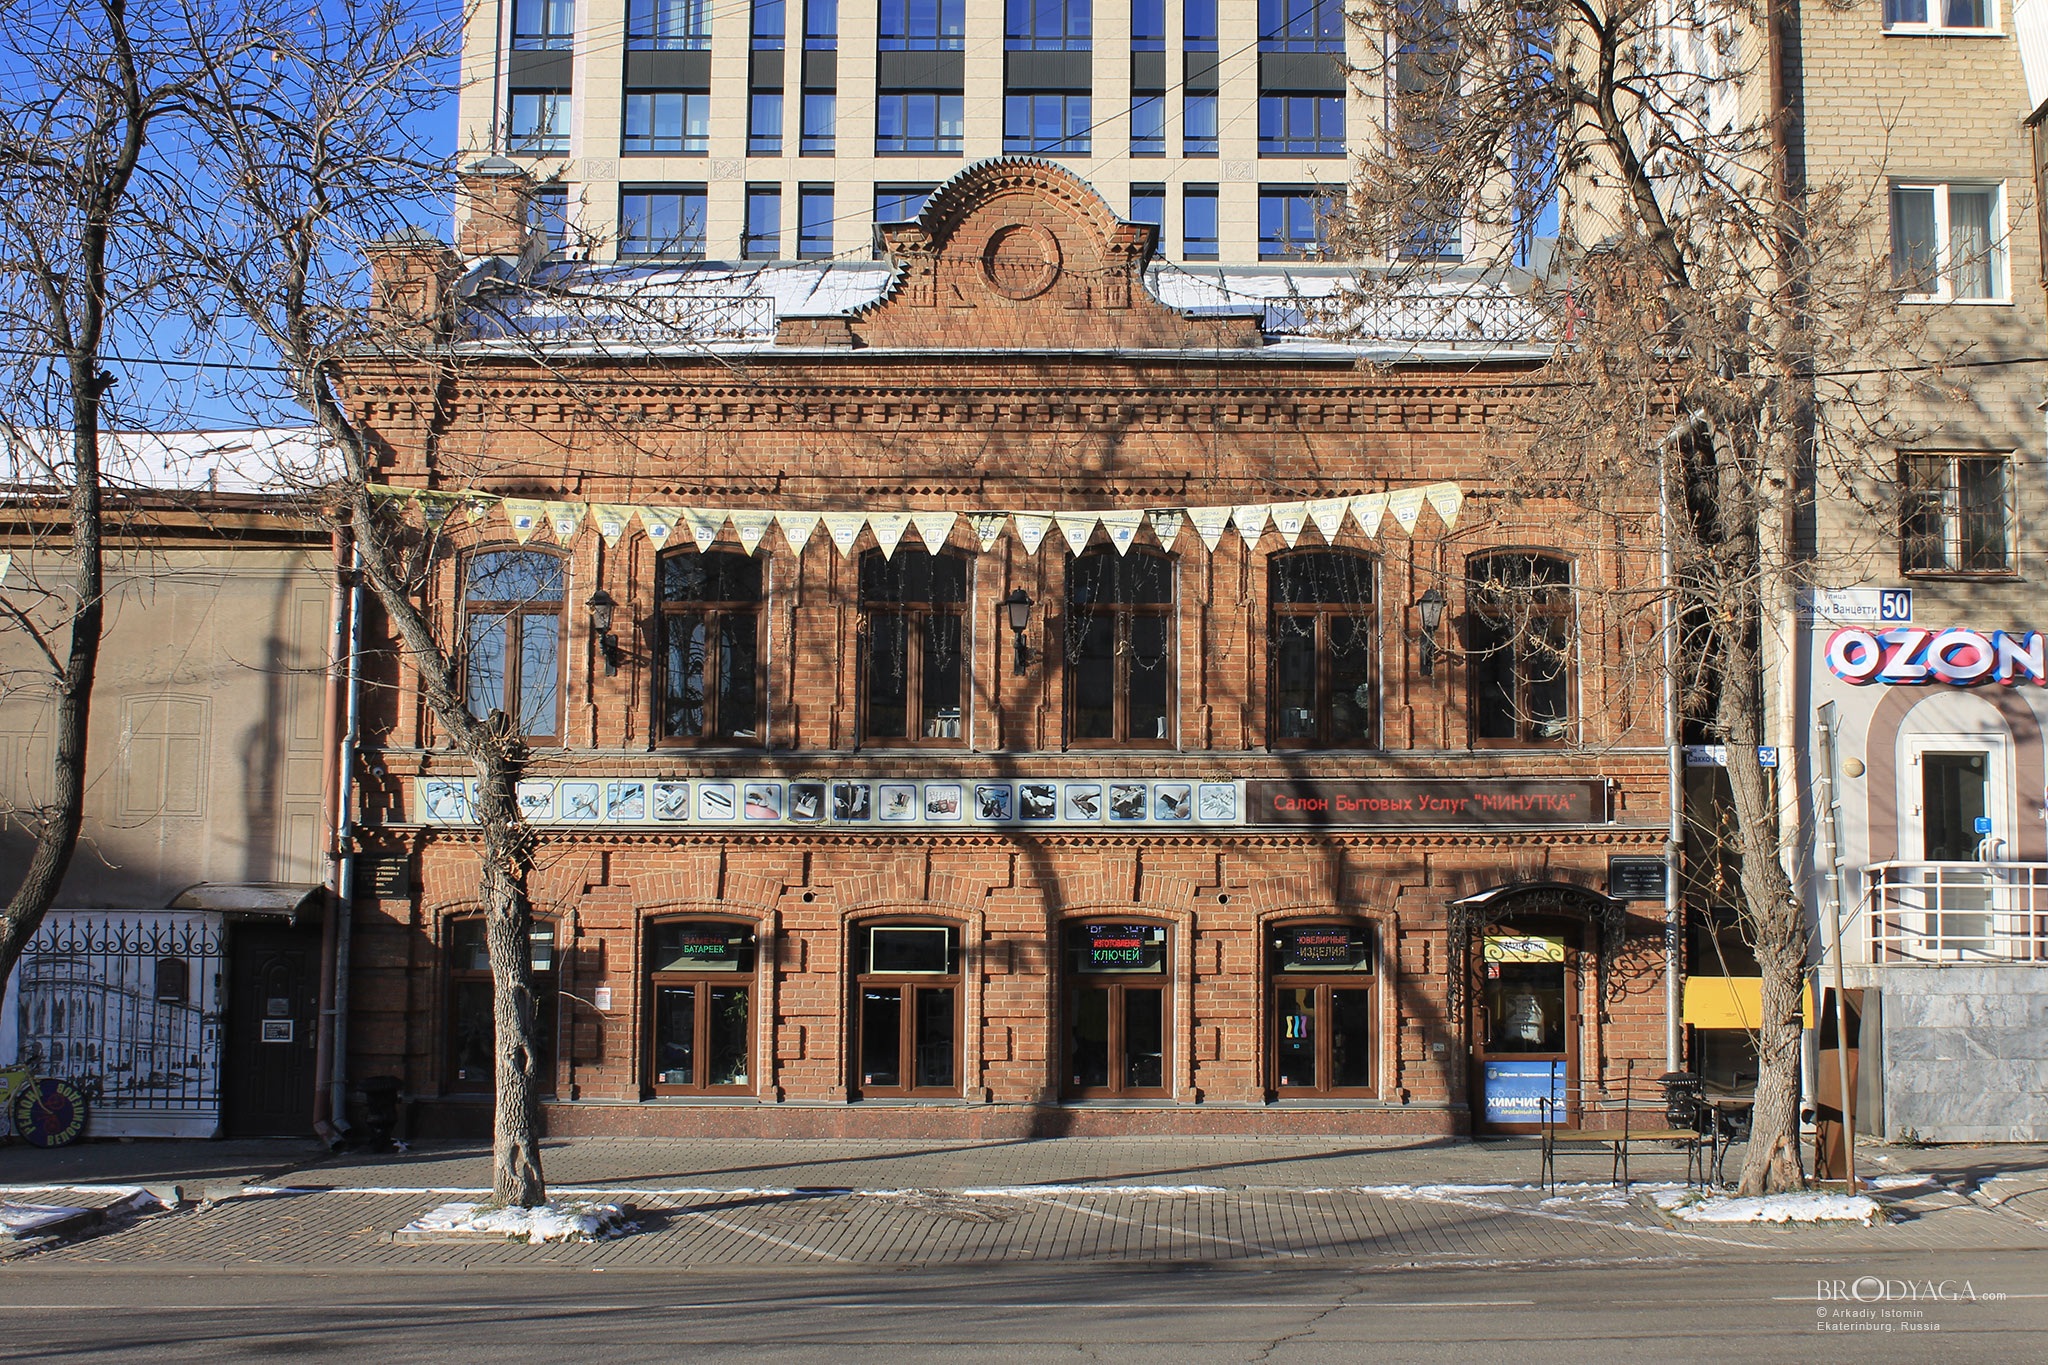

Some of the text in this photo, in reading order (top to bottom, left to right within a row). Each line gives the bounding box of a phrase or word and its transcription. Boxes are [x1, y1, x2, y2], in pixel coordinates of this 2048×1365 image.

[1833, 603, 1877, 614] Ванцетти
[1882, 592, 1909, 618] 50
[1827, 628, 2046, 683] OZON
[1758, 750, 1775, 763] 52
[1274, 793, 1576, 815] Салон Бытовых Услуг "МИНУТКА"
[1299, 936, 1347, 944] ЮВЕЛИРНЫЕ
[684, 945, 724, 953] БАТАРЕЕК
[1094, 947, 1140, 960] КЛЮЧЕЙ
[1300, 946, 1345, 958] ИЗДЕЛИЯ
